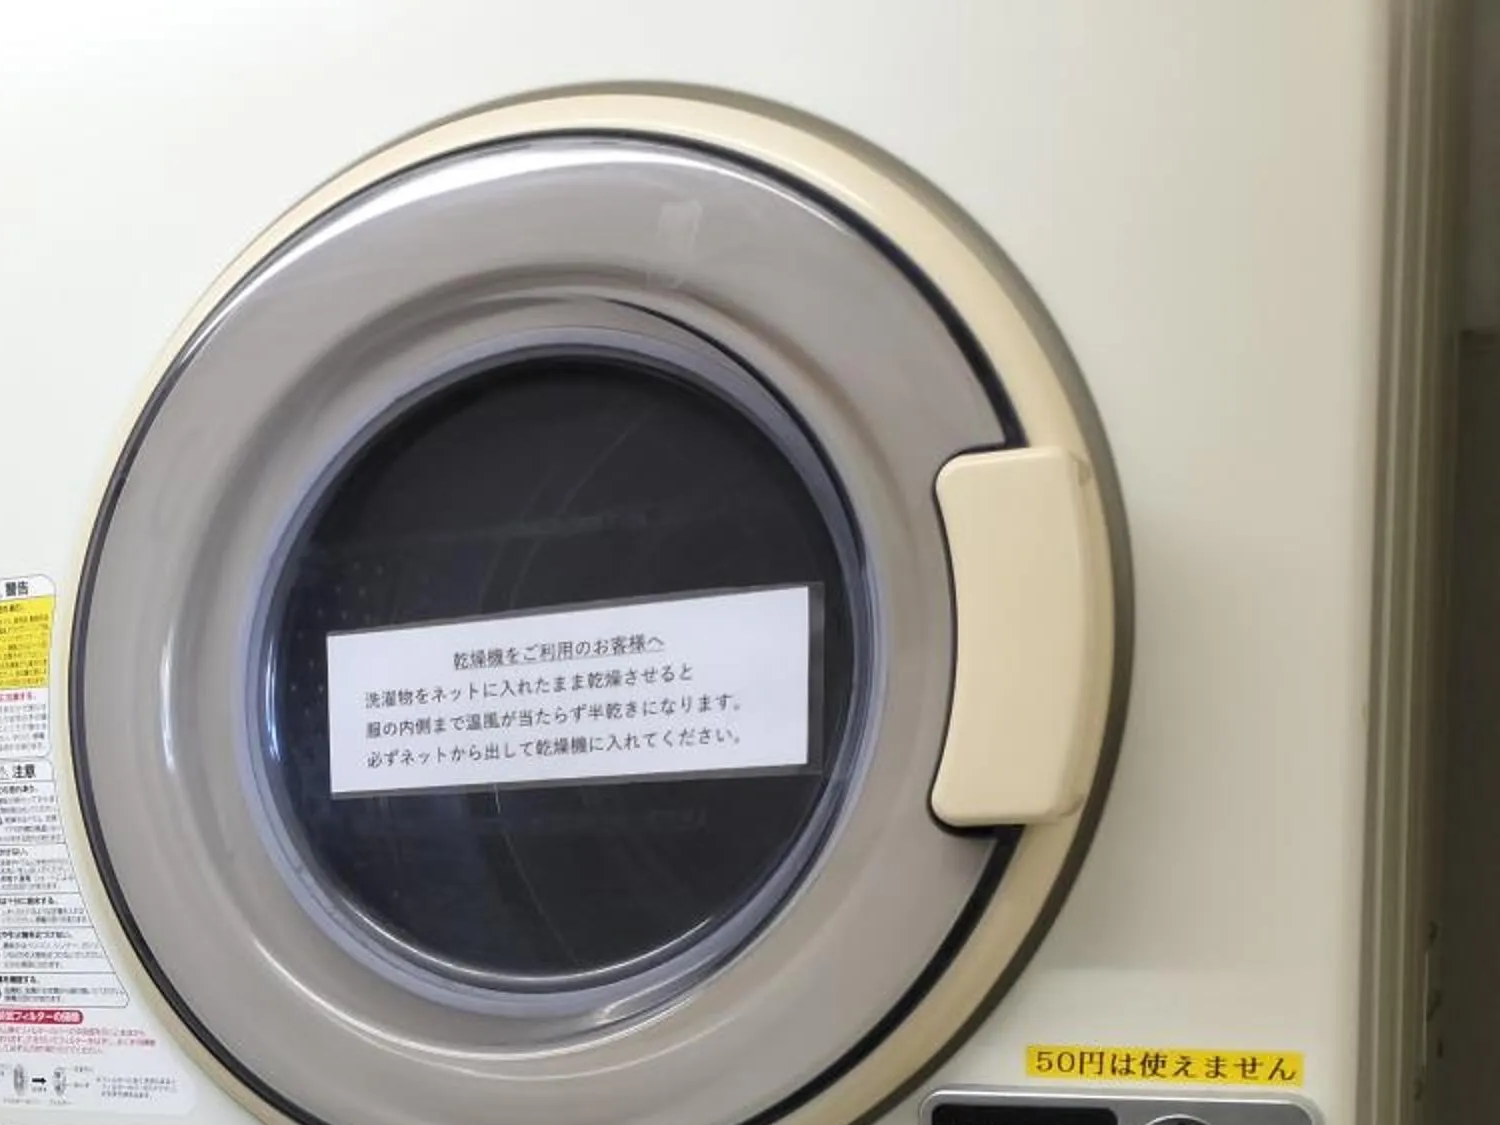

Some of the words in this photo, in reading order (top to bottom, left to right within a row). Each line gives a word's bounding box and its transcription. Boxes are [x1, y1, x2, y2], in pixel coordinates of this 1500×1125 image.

[453, 633, 666, 671] 乾燥機をご利用のお客様へ
[365, 664, 694, 710] 洗濯物をネットに入れたまま乾燥させると
[366, 693, 742, 740] 服の内側まで温風が当たらず半乾きになります。
[366, 729, 742, 769] 必ずネットから出して乾燥機に入れてください。
[1036, 1051, 1298, 1082] 50円は使えません
